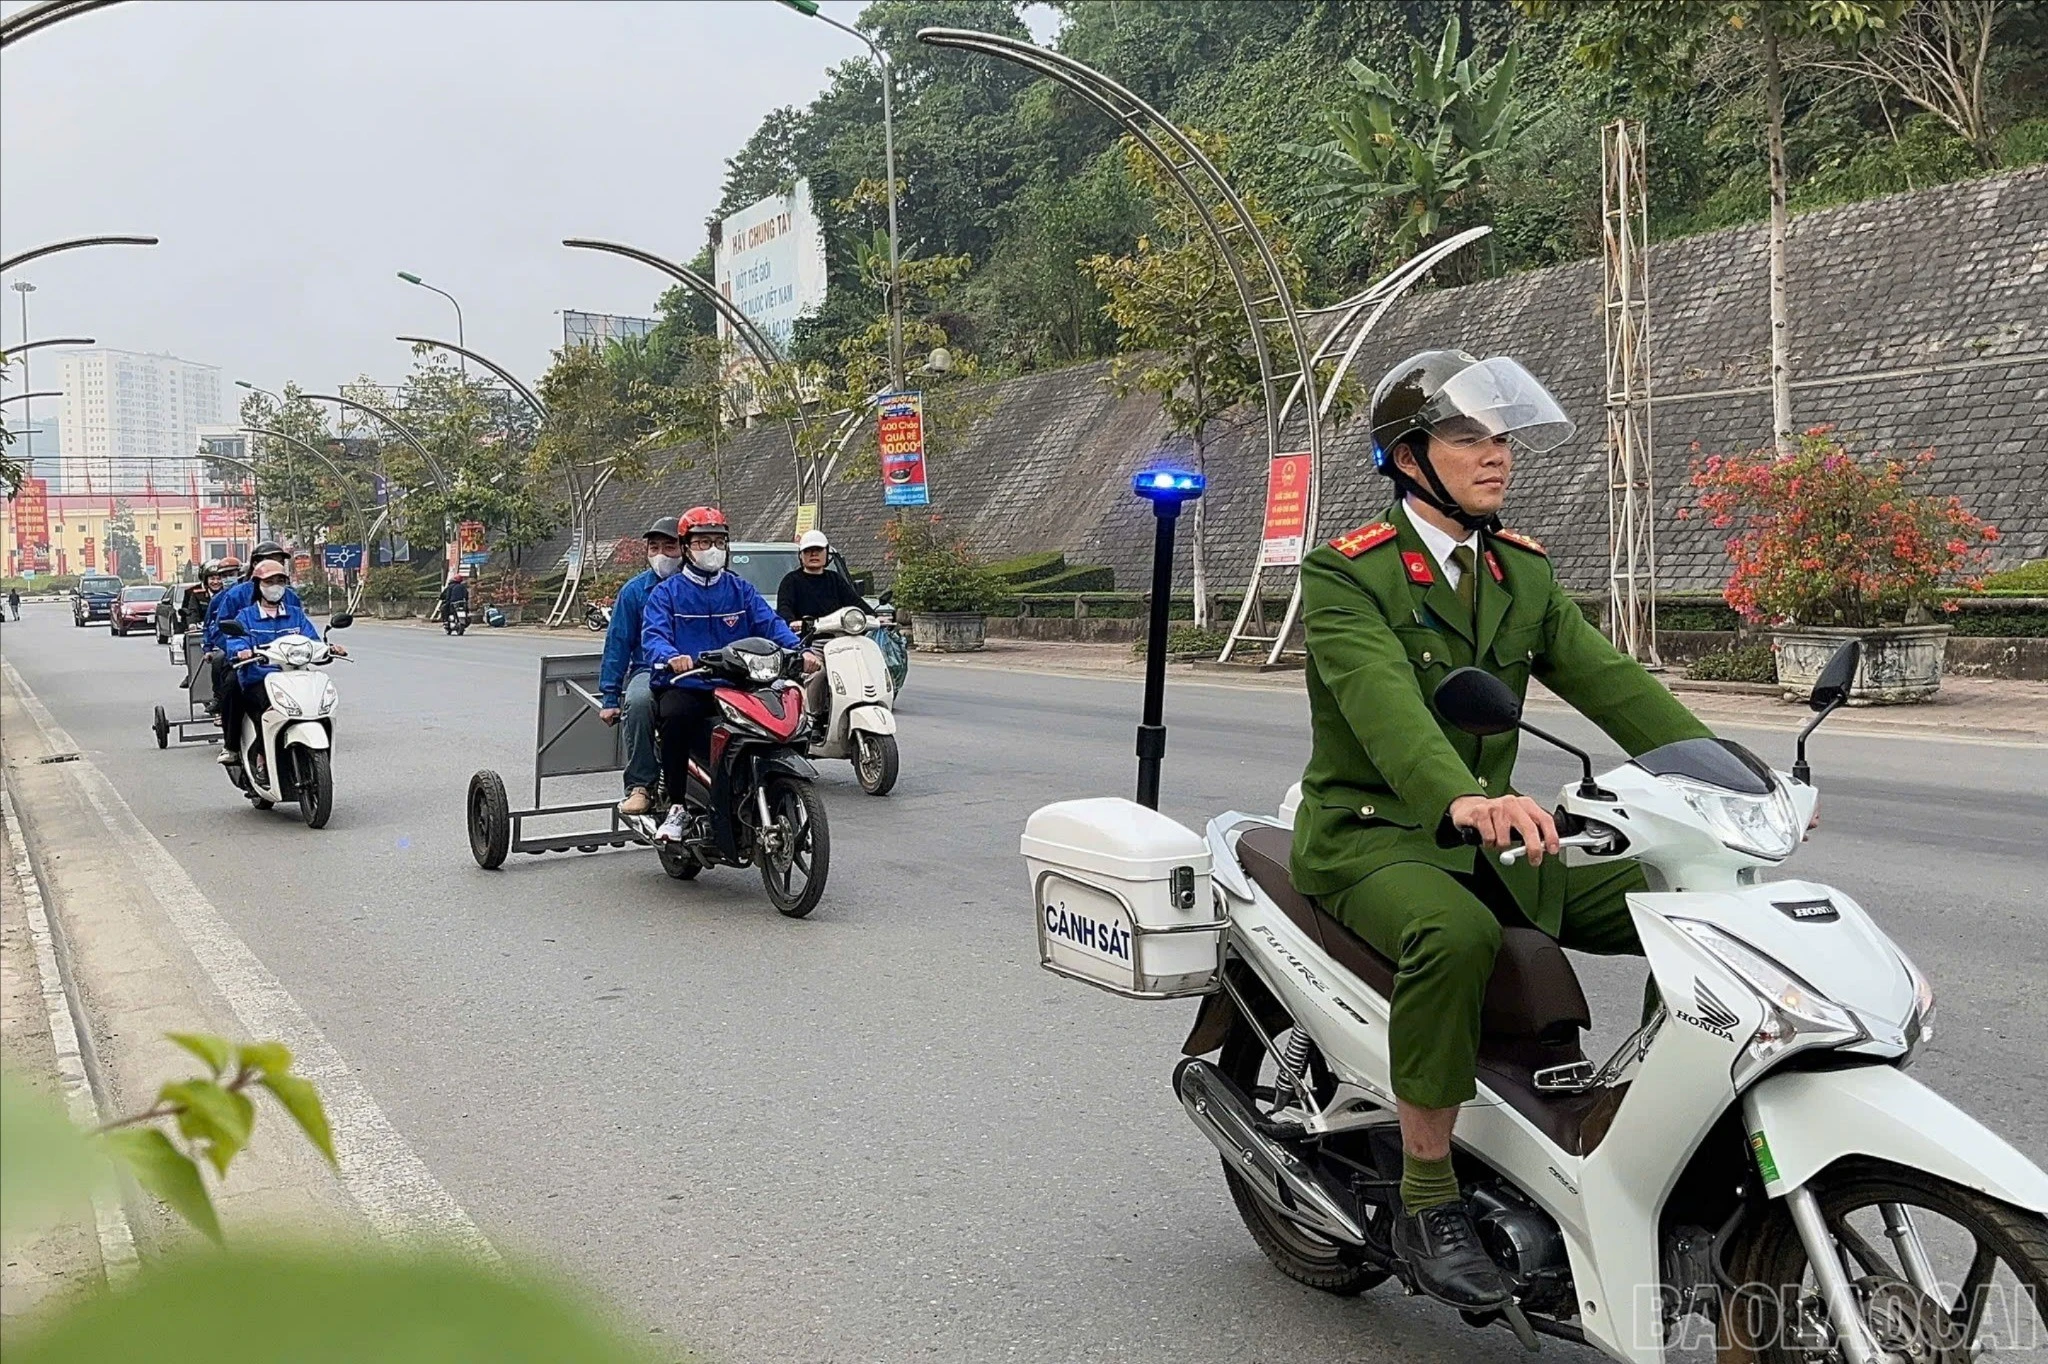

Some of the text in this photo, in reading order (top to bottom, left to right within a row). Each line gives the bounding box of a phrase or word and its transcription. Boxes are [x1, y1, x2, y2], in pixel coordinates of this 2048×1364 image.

[748, 218, 775, 249] CHUNG
[777, 211, 791, 236] TAY
[1793, 905, 1836, 918] HOND
[1046, 901, 1130, 960] CẢNH SÁT
[1676, 1009, 1735, 1042] HONDA
